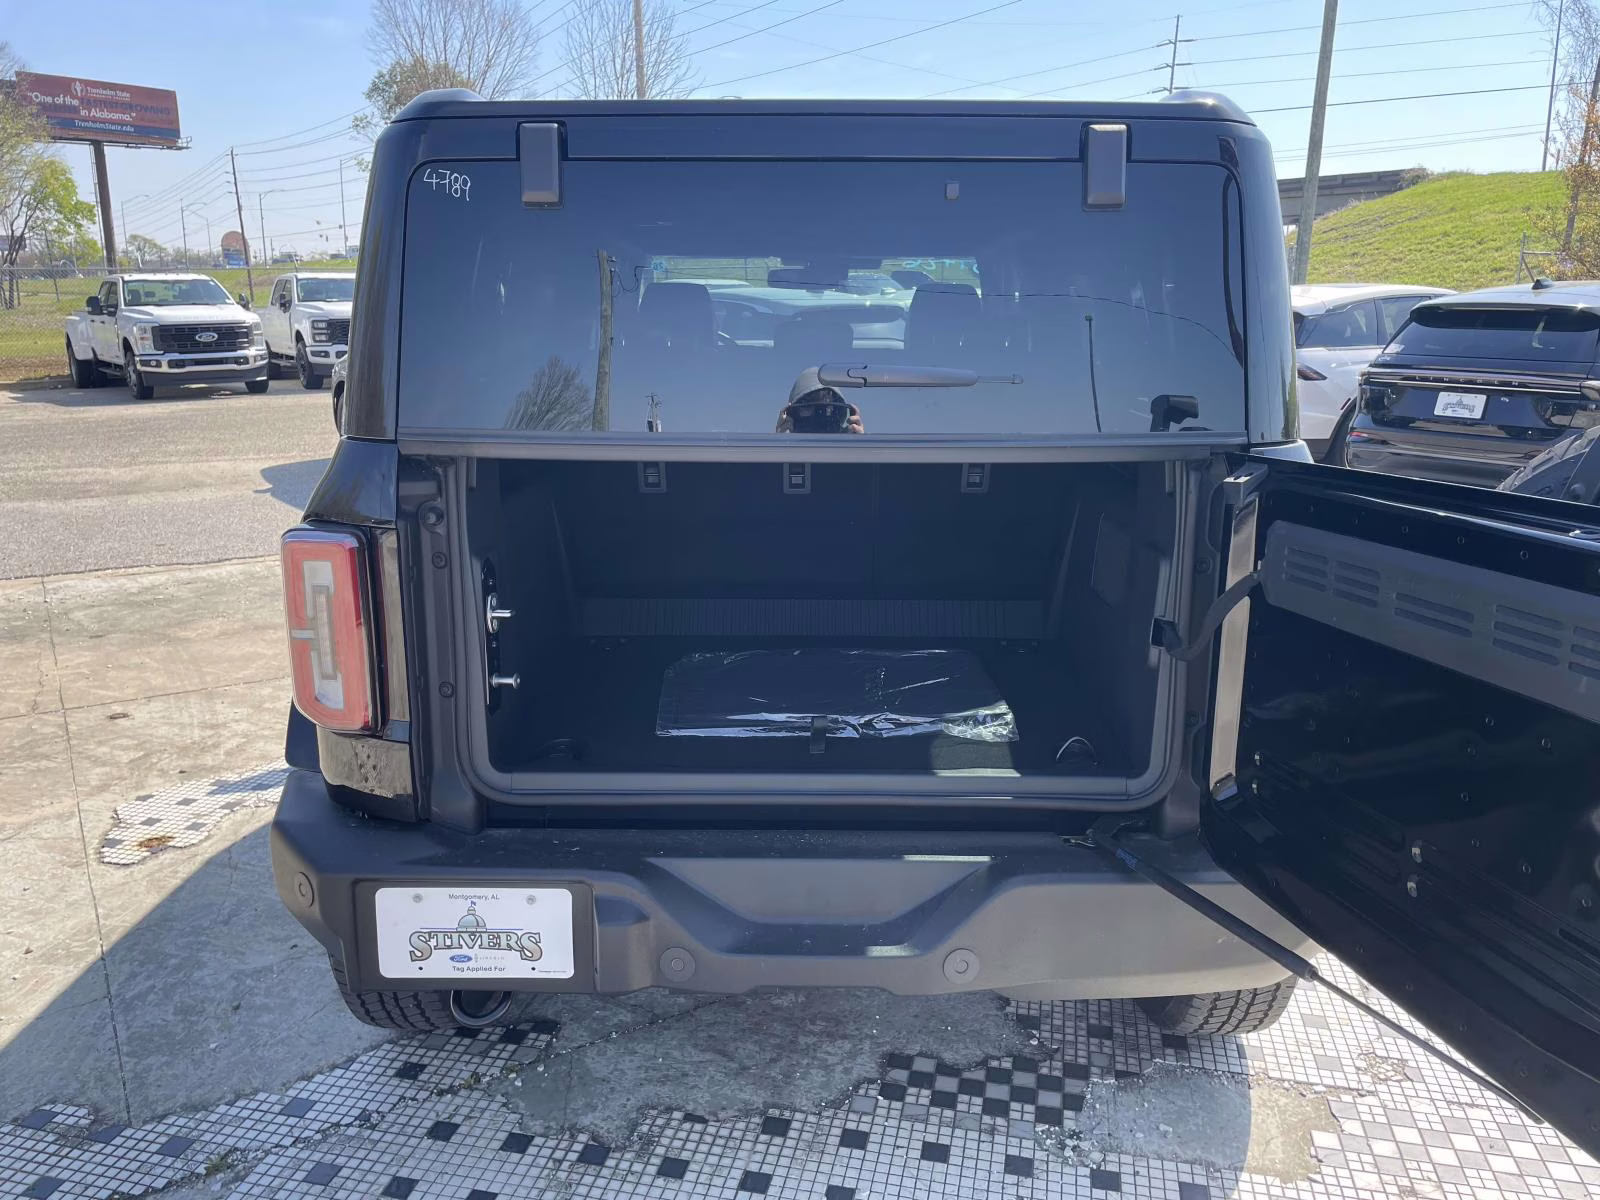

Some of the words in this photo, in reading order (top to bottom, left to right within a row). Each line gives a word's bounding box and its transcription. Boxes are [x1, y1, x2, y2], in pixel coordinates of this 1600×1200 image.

[116, 90, 131, 98] State
[54, 94, 64, 104] of
[65, 95, 79, 106] the
[80, 106, 89, 117] in
[74, 119, 135, 132] TrenholmState.edu
[423, 168, 471, 202] 4789
[1416, 376, 1518, 386] LINCOLN
[448, 893, 490, 901] Montgomery,
[409, 931, 543, 962] STIVERS
